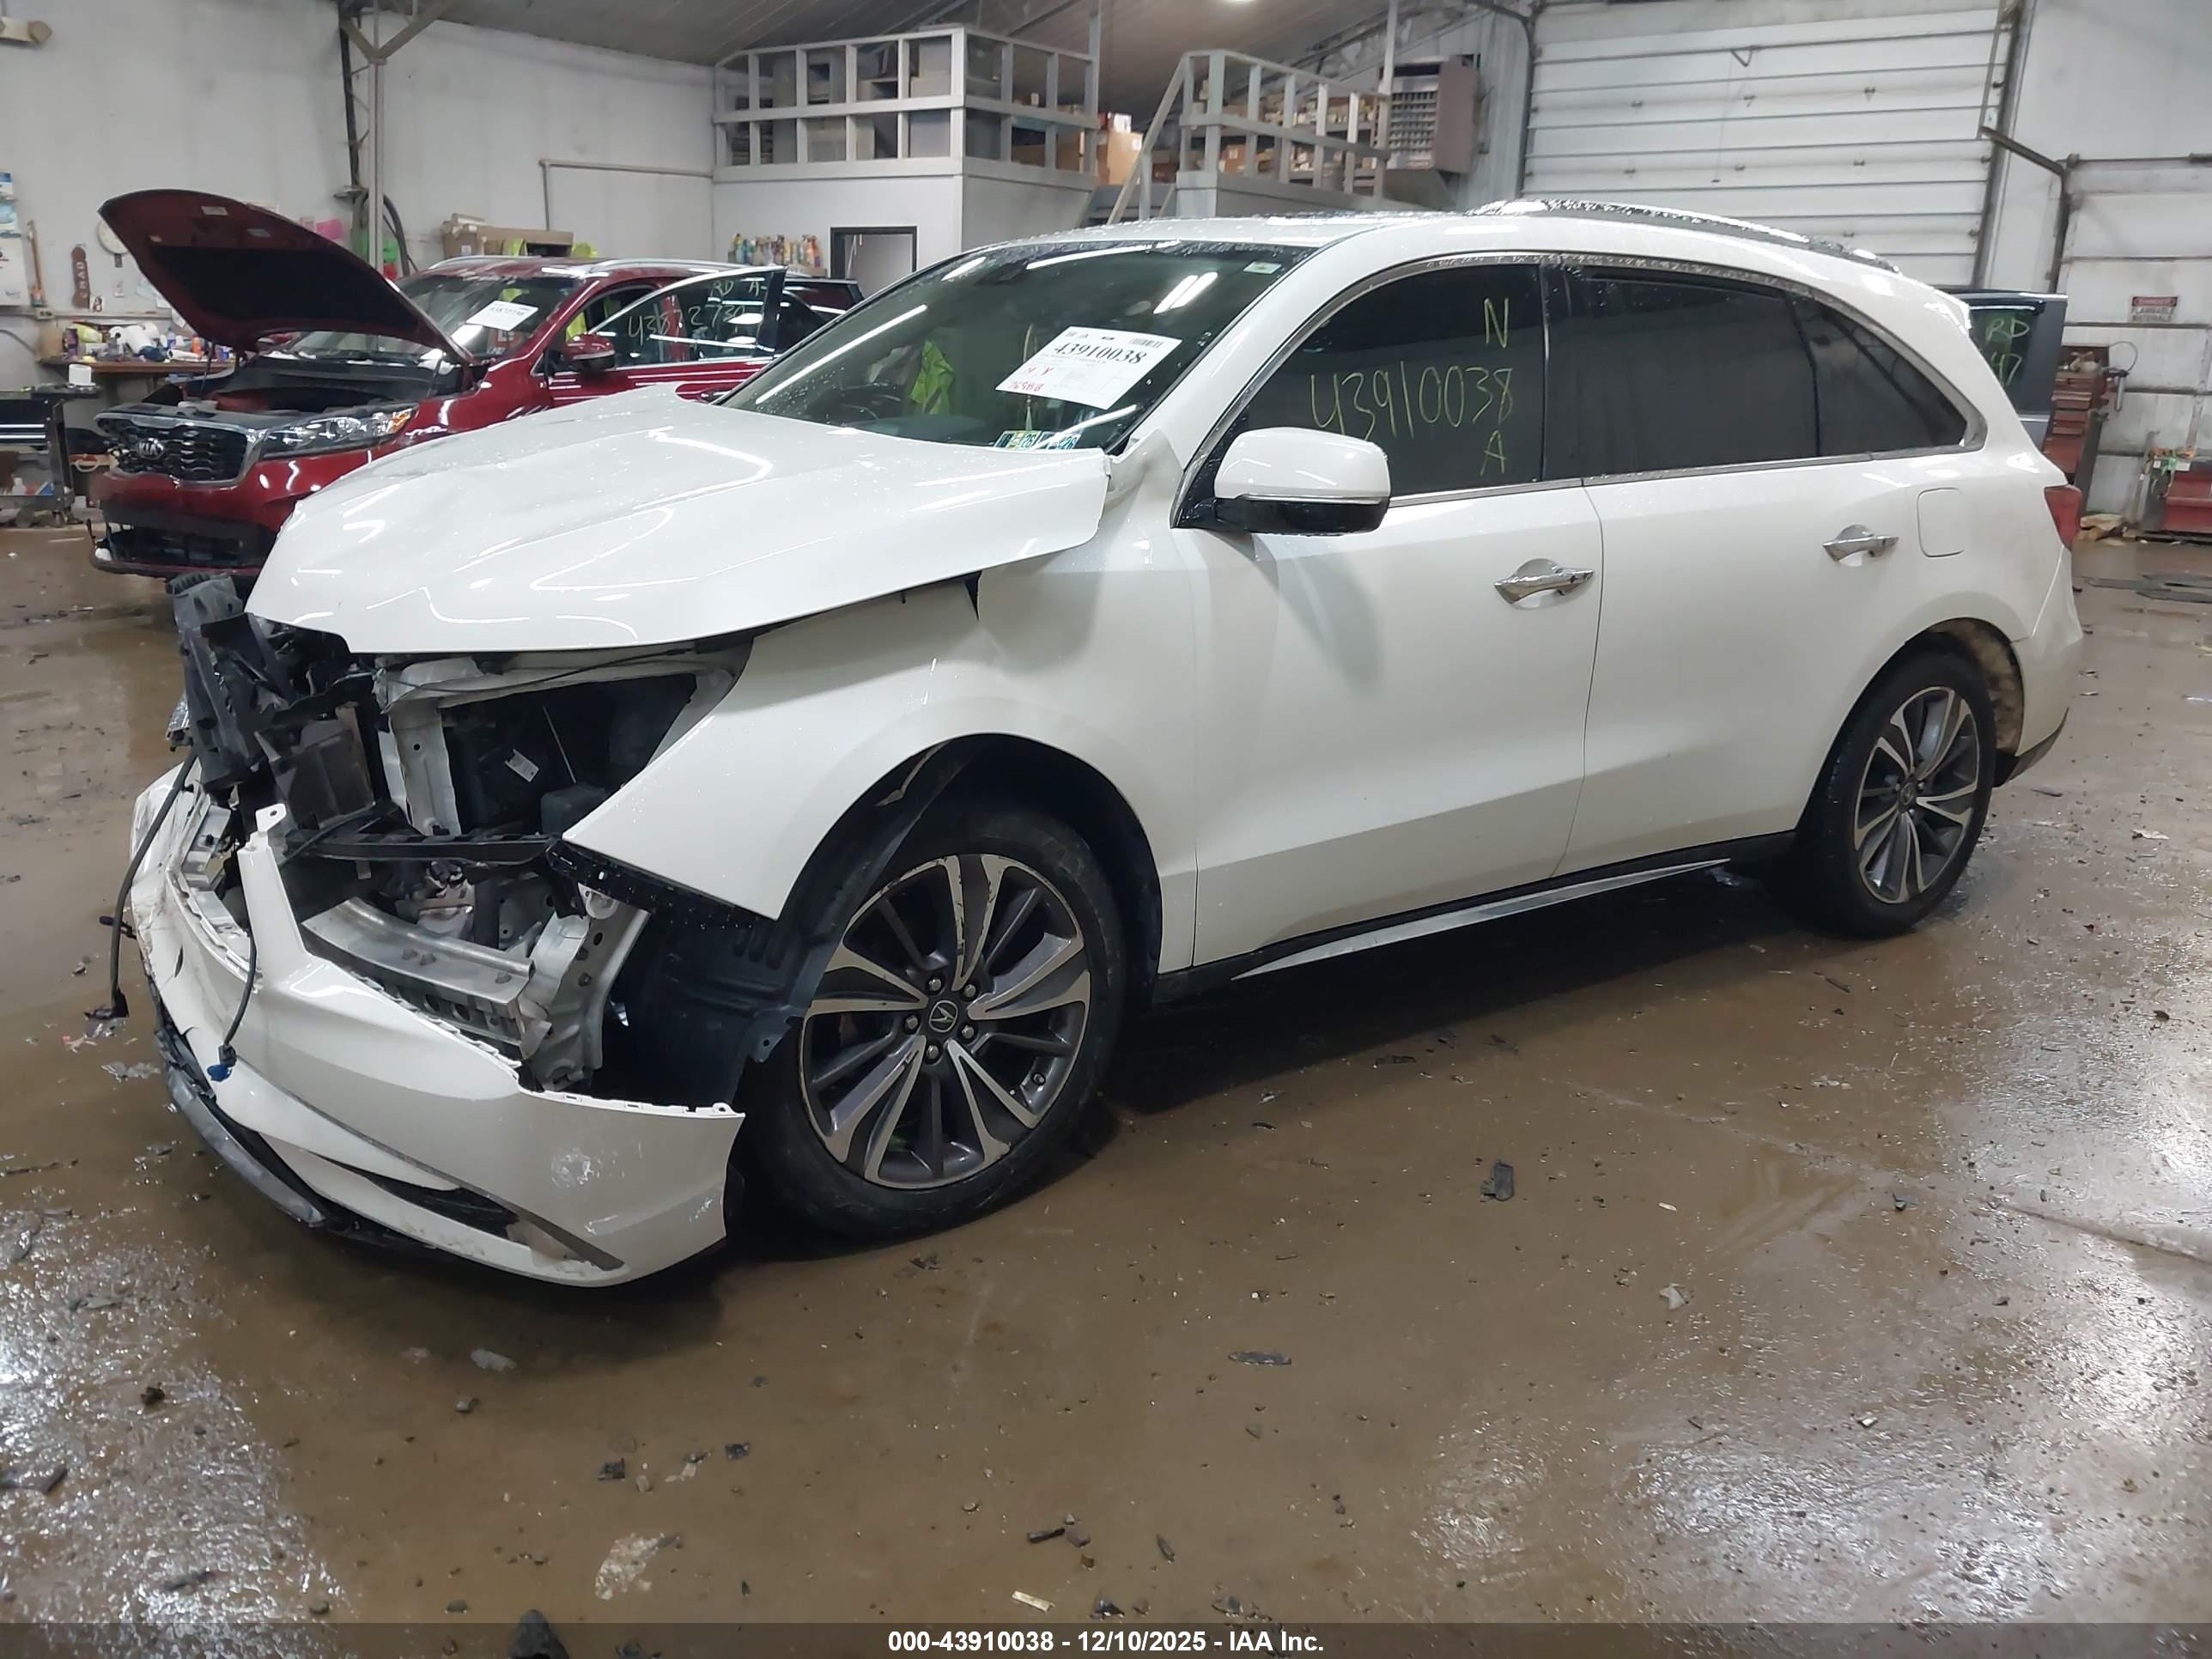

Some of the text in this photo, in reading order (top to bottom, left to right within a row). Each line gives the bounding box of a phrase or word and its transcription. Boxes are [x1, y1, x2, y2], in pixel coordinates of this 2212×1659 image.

[1483, 297, 1510, 349] N
[1985, 318, 2030, 343] RD
[1054, 341, 1147, 365] 43910038
[1310, 360, 1513, 441] 43910038
[1479, 429, 1507, 476] A
